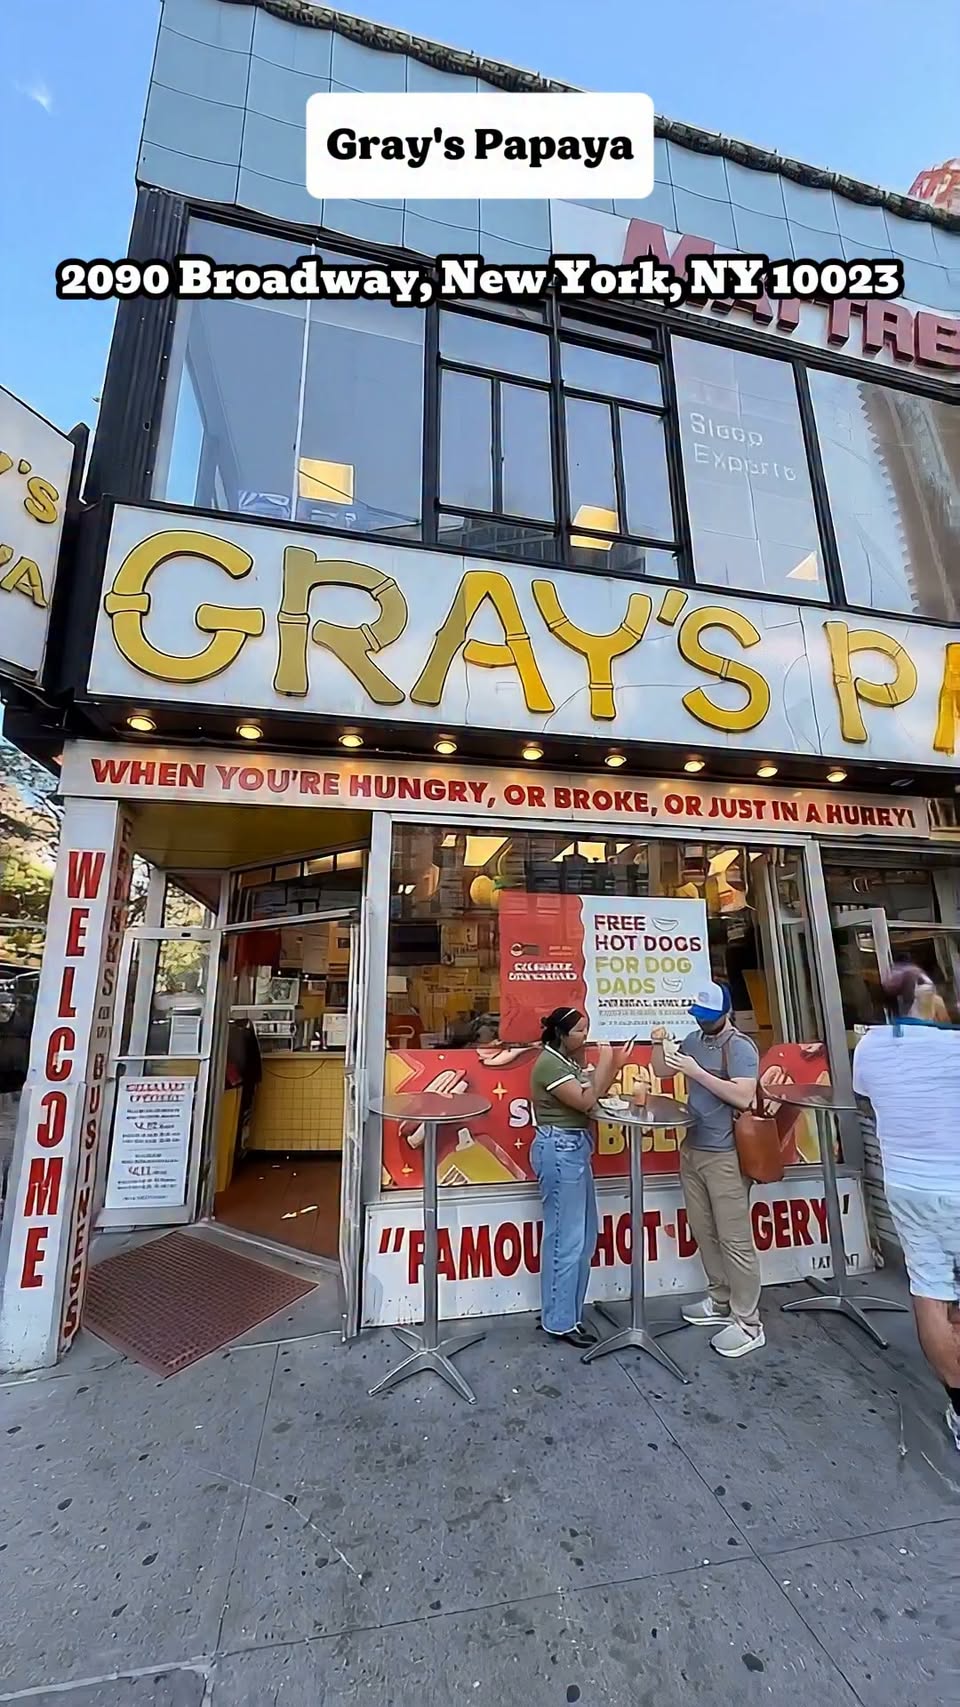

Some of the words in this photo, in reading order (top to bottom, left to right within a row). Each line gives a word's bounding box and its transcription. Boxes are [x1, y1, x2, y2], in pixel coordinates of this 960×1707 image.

[104, 529, 771, 733] GRAY'S
[91, 758, 206, 788] WHEN
[215, 764, 341, 797] YOU'RE
[349, 773, 496, 809] HUNGRY,
[503, 784, 548, 808] OR
[554, 786, 658, 818] BROKE,
[664, 792, 703, 818] OR
[708, 796, 769, 821] JUST
[772, 800, 800, 823] IN
[805, 802, 823, 824] A
[594, 914, 647, 932] FREE
[594, 934, 638, 952] HOT
[644, 936, 702, 952] DOGS
[594, 956, 640, 974] FOR
[644, 956, 692, 974] DOG
[596, 978, 656, 996] DADS
[19, 849, 107, 1291] WELCOME
[378, 1219, 542, 1285] "FAMOU
